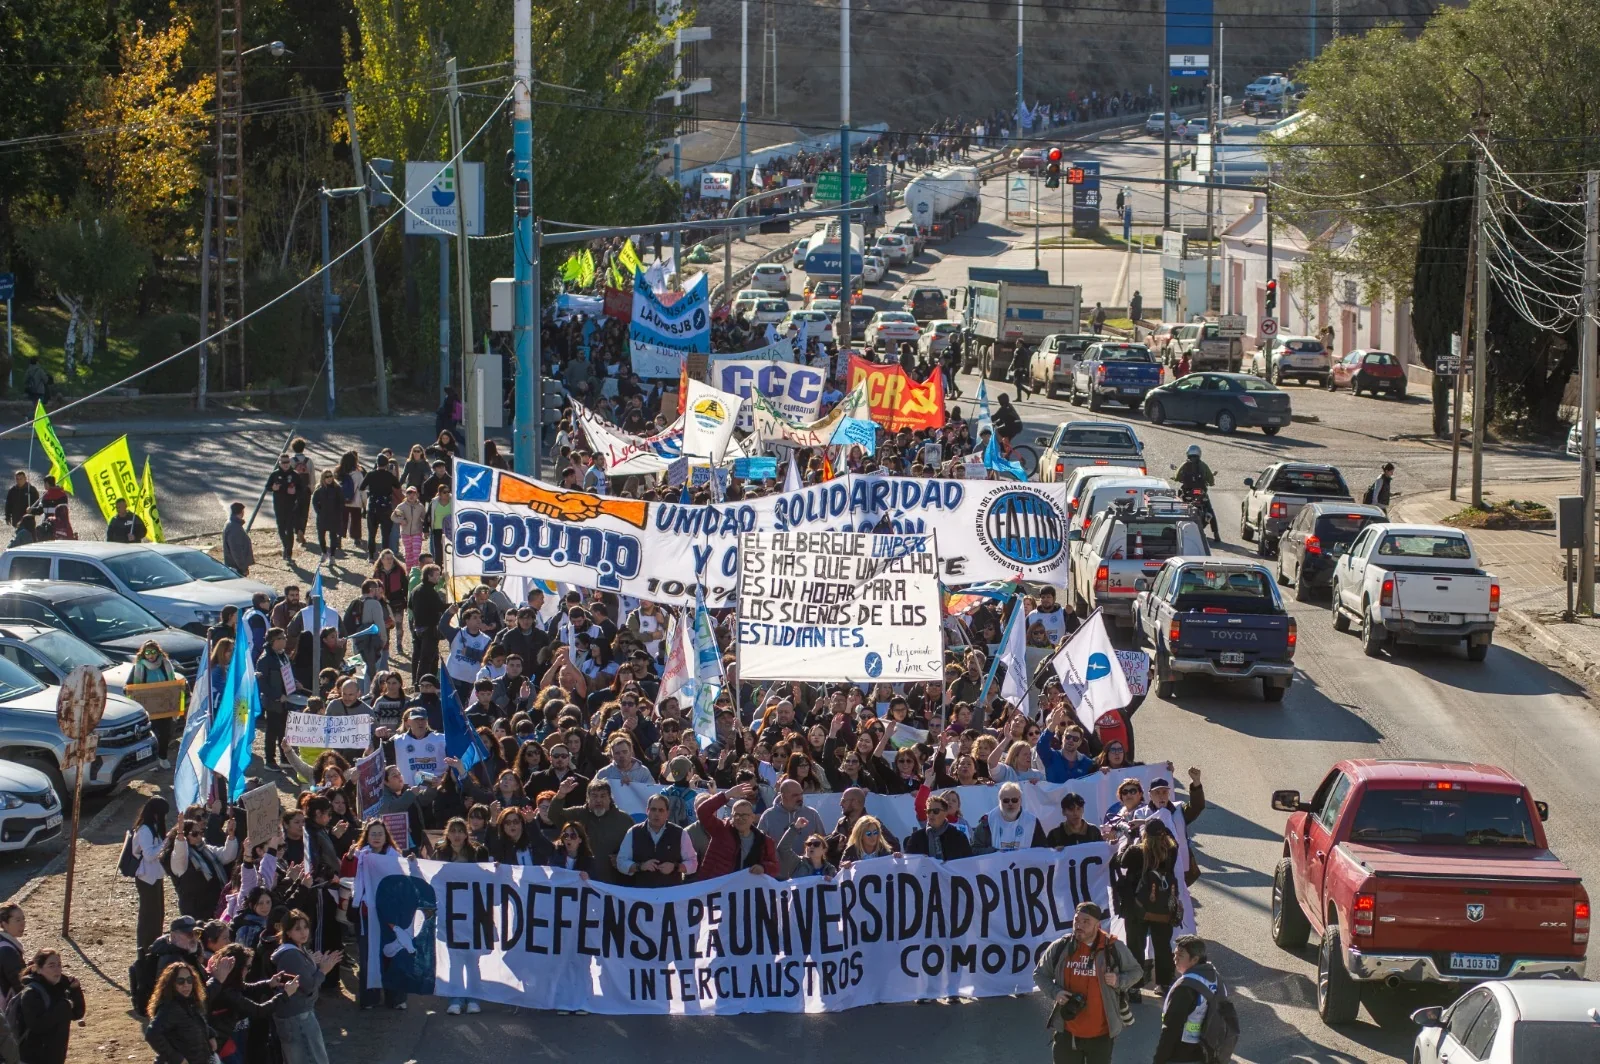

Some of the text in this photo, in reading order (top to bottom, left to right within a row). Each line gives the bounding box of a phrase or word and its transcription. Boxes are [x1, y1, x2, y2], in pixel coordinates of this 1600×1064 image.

[412, 217, 472, 229] pefumea
[420, 206, 456, 215] farmac
[823, 260, 842, 268] YP
[639, 305, 653, 323] LA
[721, 365, 821, 404] CCC
[116, 460, 137, 507] AESA
[988, 484, 1033, 497] TRABAJADOR
[774, 478, 965, 531] SOLIDARIDAD
[979, 495, 993, 509] DEL
[975, 508, 988, 546] ARGENTINA
[995, 495, 1061, 559] FATUN
[744, 533, 767, 550] EL
[771, 533, 866, 557] ALBERGUE
[692, 544, 713, 577] Y
[743, 551, 766, 574] ES
[770, 551, 807, 577] MÁS
[813, 555, 851, 581] QUE
[855, 556, 878, 580] UN
[647, 577, 738, 604] 100%
[742, 575, 907, 605] ES UN HOGAR PARA
[1109, 578, 1122, 588] 34
[739, 598, 928, 627] LOS SUEÑOS DE LOS
[738, 621, 870, 650] ESTUDIANTES.
[1210, 629, 1259, 641] TOYOTA
[1114, 649, 1146, 662] ERSIDAD
[339, 735, 350, 744] UN
[351, 733, 372, 746] DEREC
[687, 892, 723, 928] DE
[975, 855, 1108, 939] PÚBLIC
[499, 883, 683, 962] DEFENSA
[728, 871, 975, 957] UNIVERSIDAD
[688, 928, 720, 959] LA
[629, 951, 864, 1002] INTERCLAUSTROS
[1067, 961, 1089, 969] NORT
[1452, 958, 1464, 968] AA
[1466, 958, 1484, 969] 103
